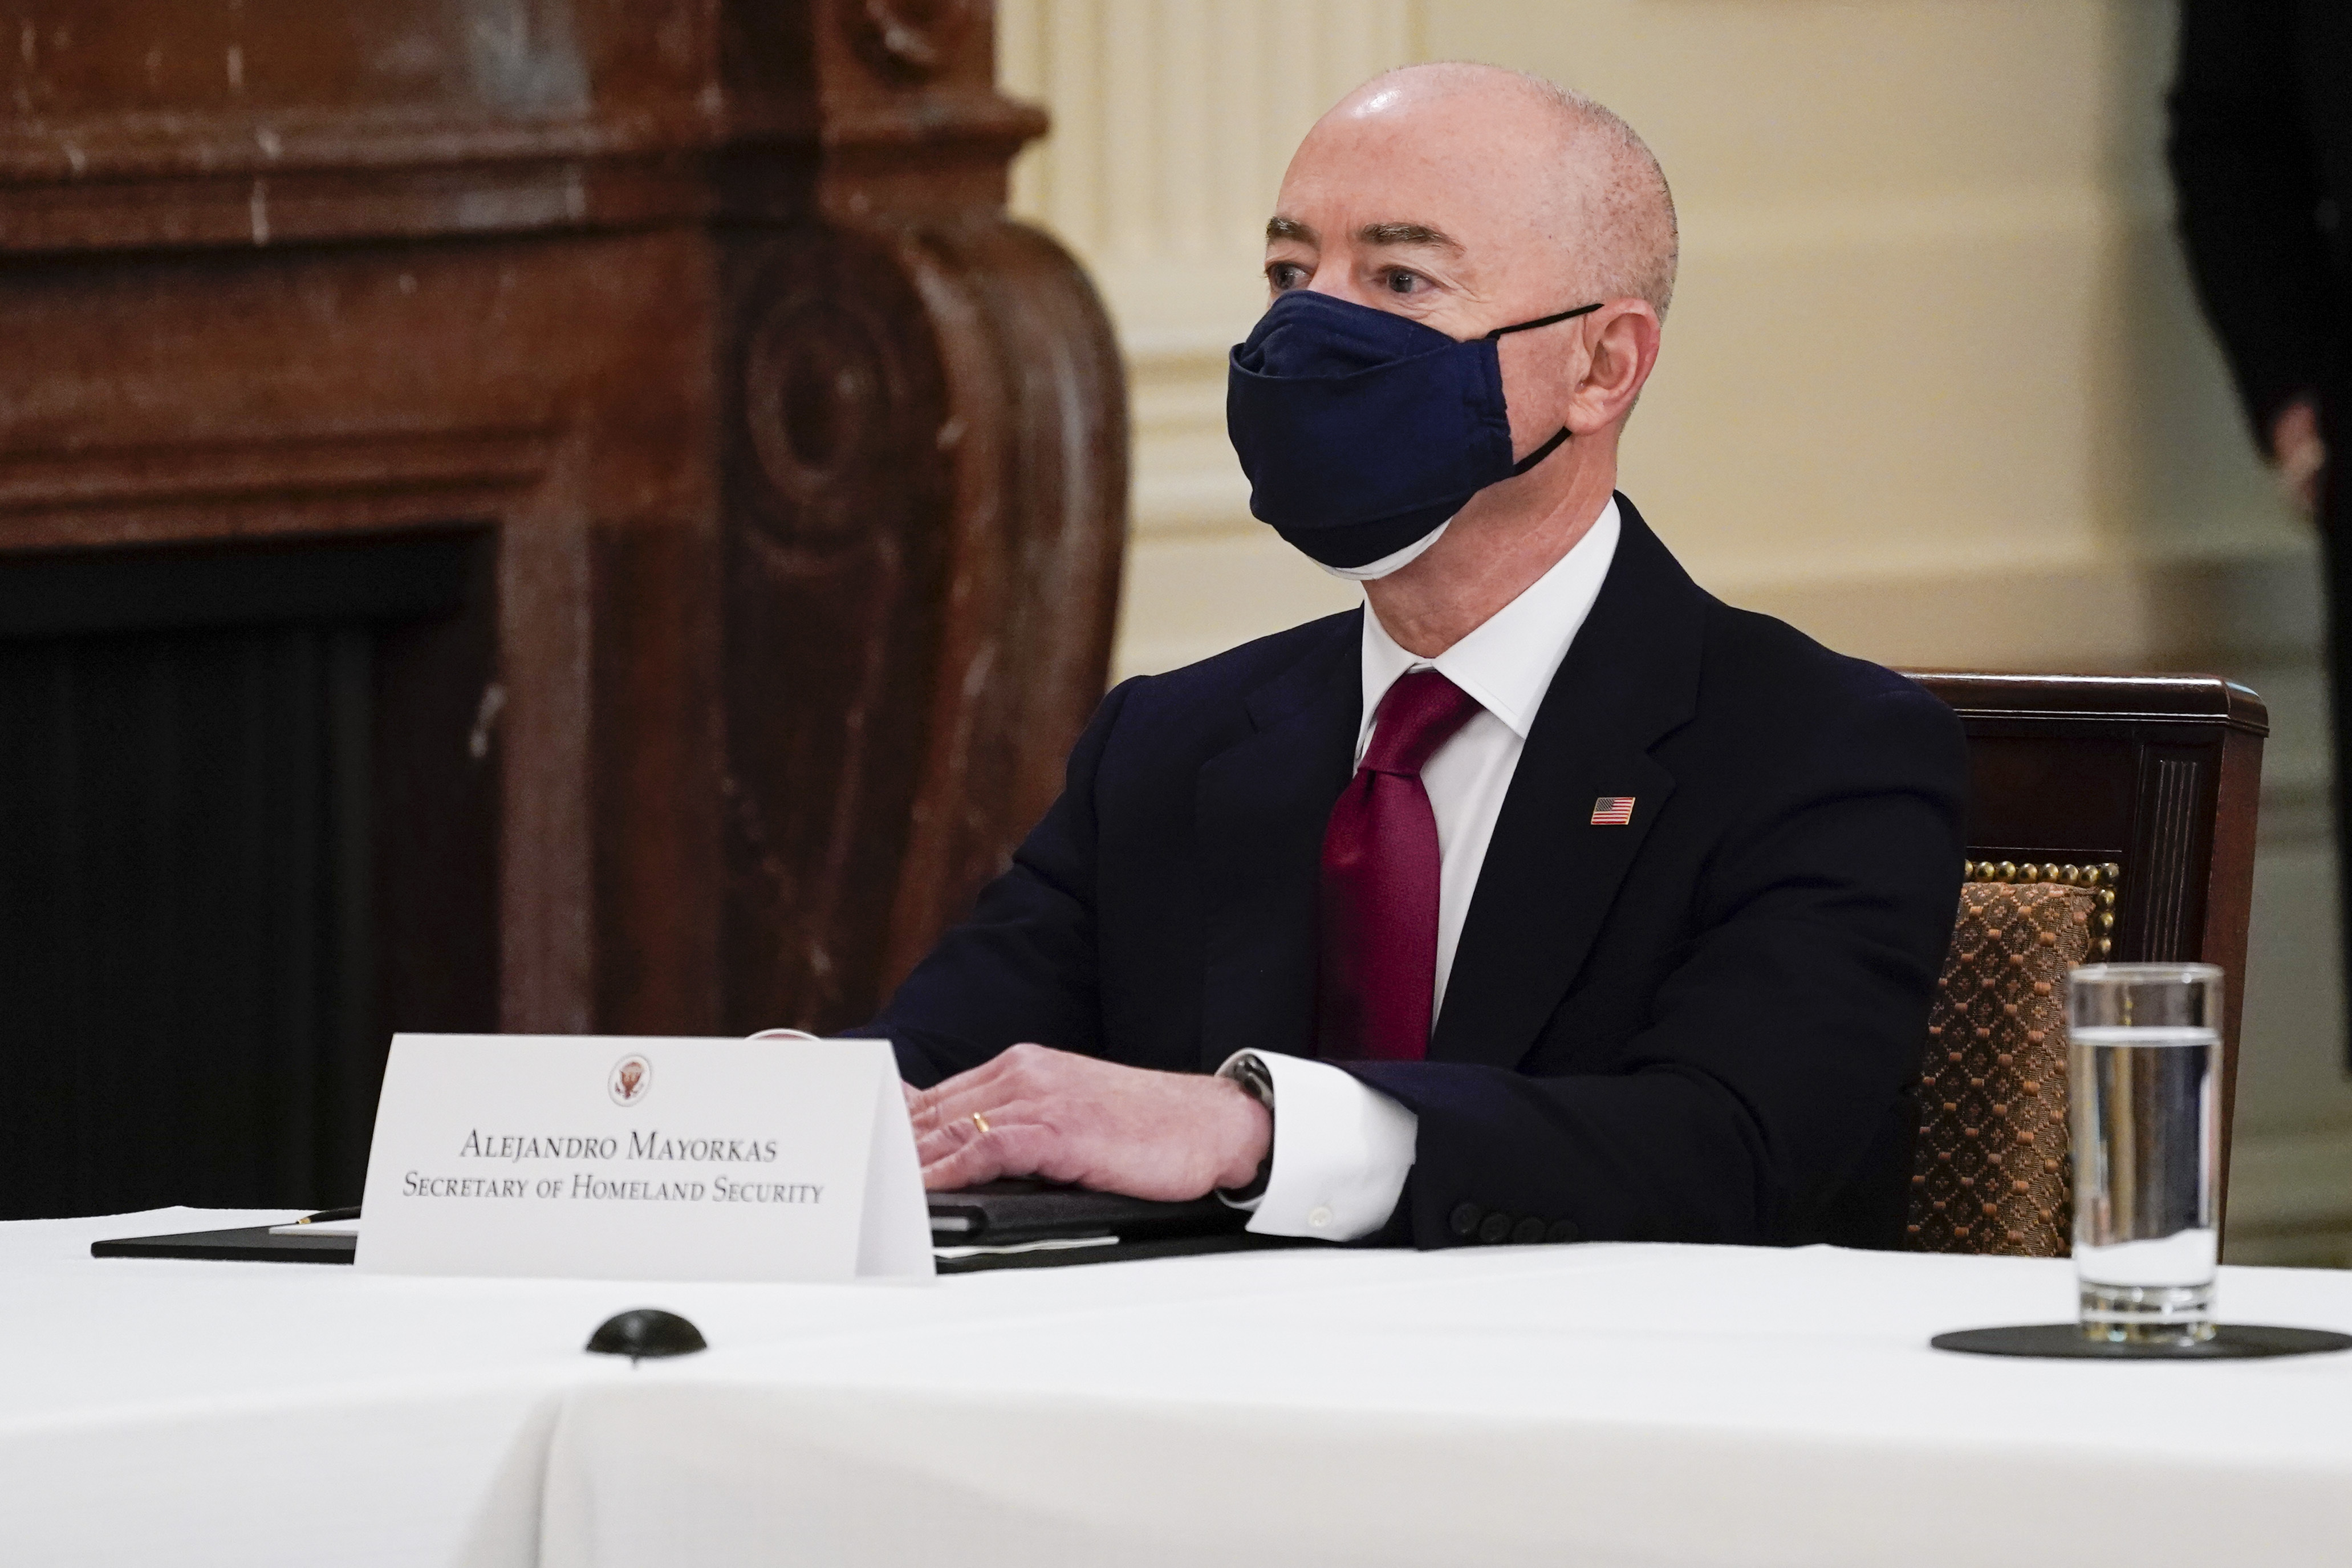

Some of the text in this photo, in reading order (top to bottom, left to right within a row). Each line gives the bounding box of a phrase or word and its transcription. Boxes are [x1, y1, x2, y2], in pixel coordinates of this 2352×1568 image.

[460, 1128, 778, 1162] ALEJANDRO MAYORKAS
[402, 1170, 527, 1199] SECRETARY
[571, 1173, 706, 1201] HOMELAND
[713, 1175, 823, 1204] SECURITY
